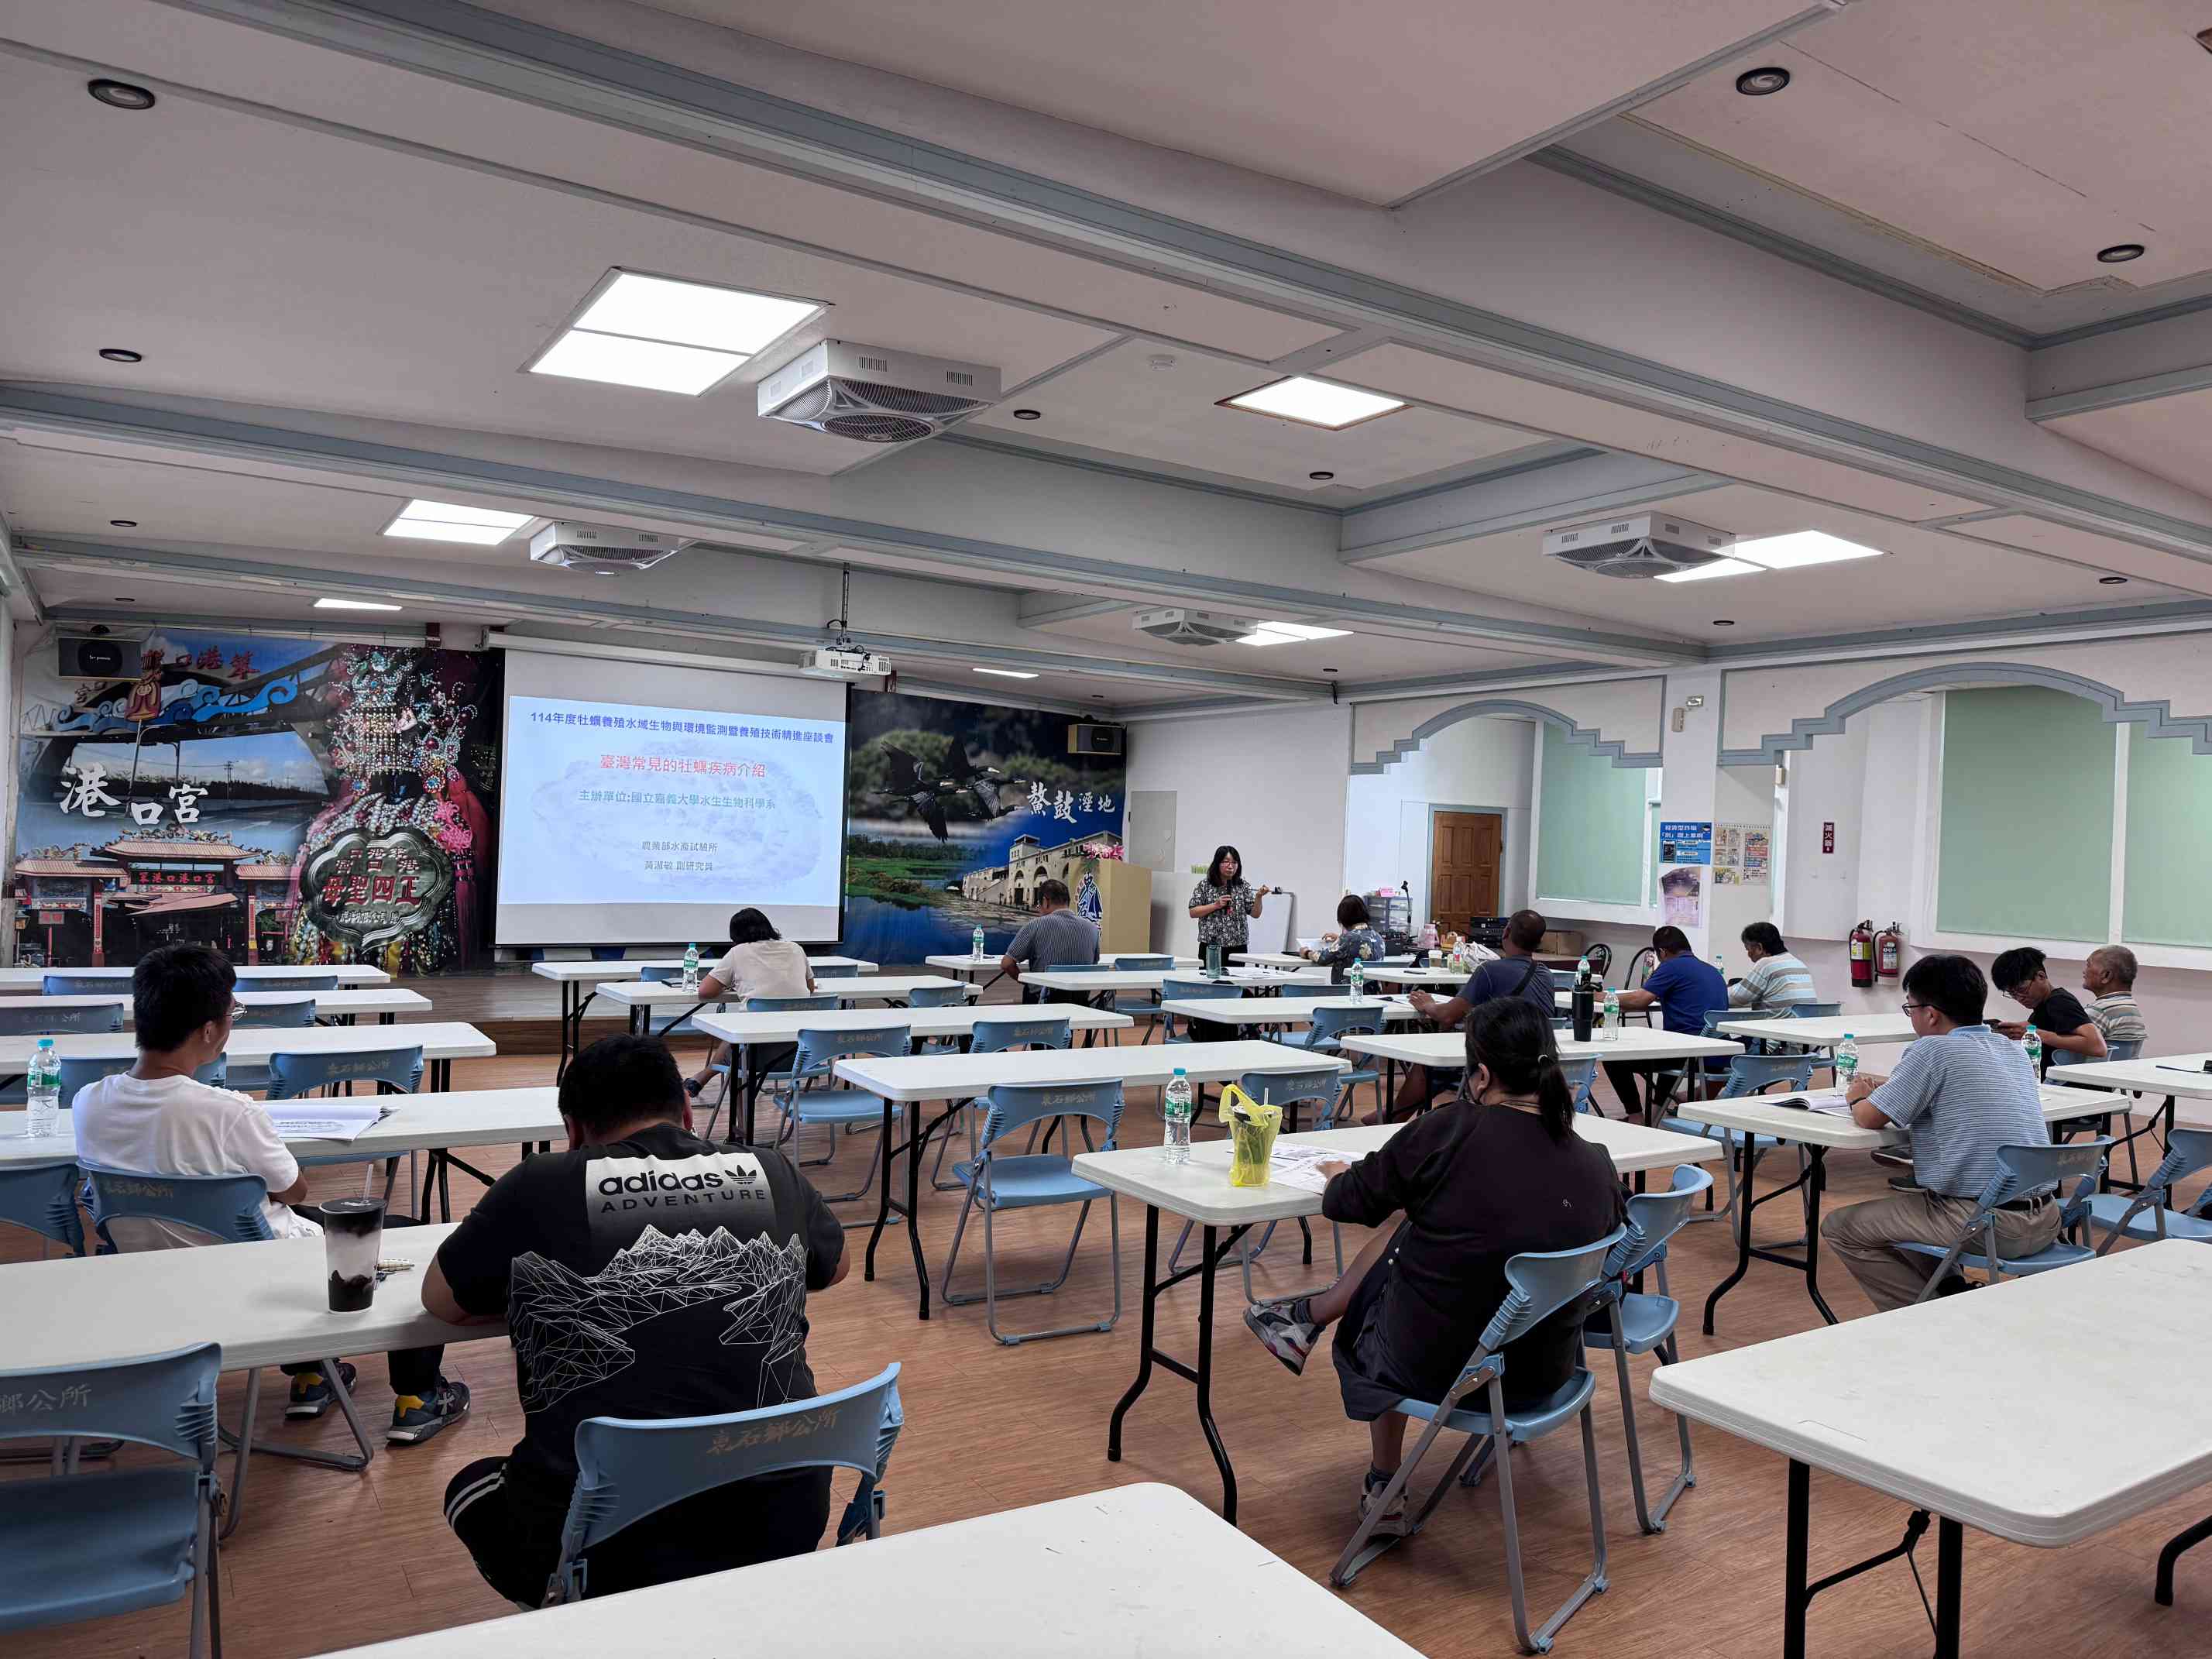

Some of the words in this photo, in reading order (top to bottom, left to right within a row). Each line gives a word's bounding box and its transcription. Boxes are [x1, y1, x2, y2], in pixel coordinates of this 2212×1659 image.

[600, 754, 767, 778] 臺灣常見的牡蠣疾病介紹
[59, 761, 208, 826] 港口宮
[598, 1170, 724, 1197] adidas
[600, 1189, 767, 1214] ADVENTURE
